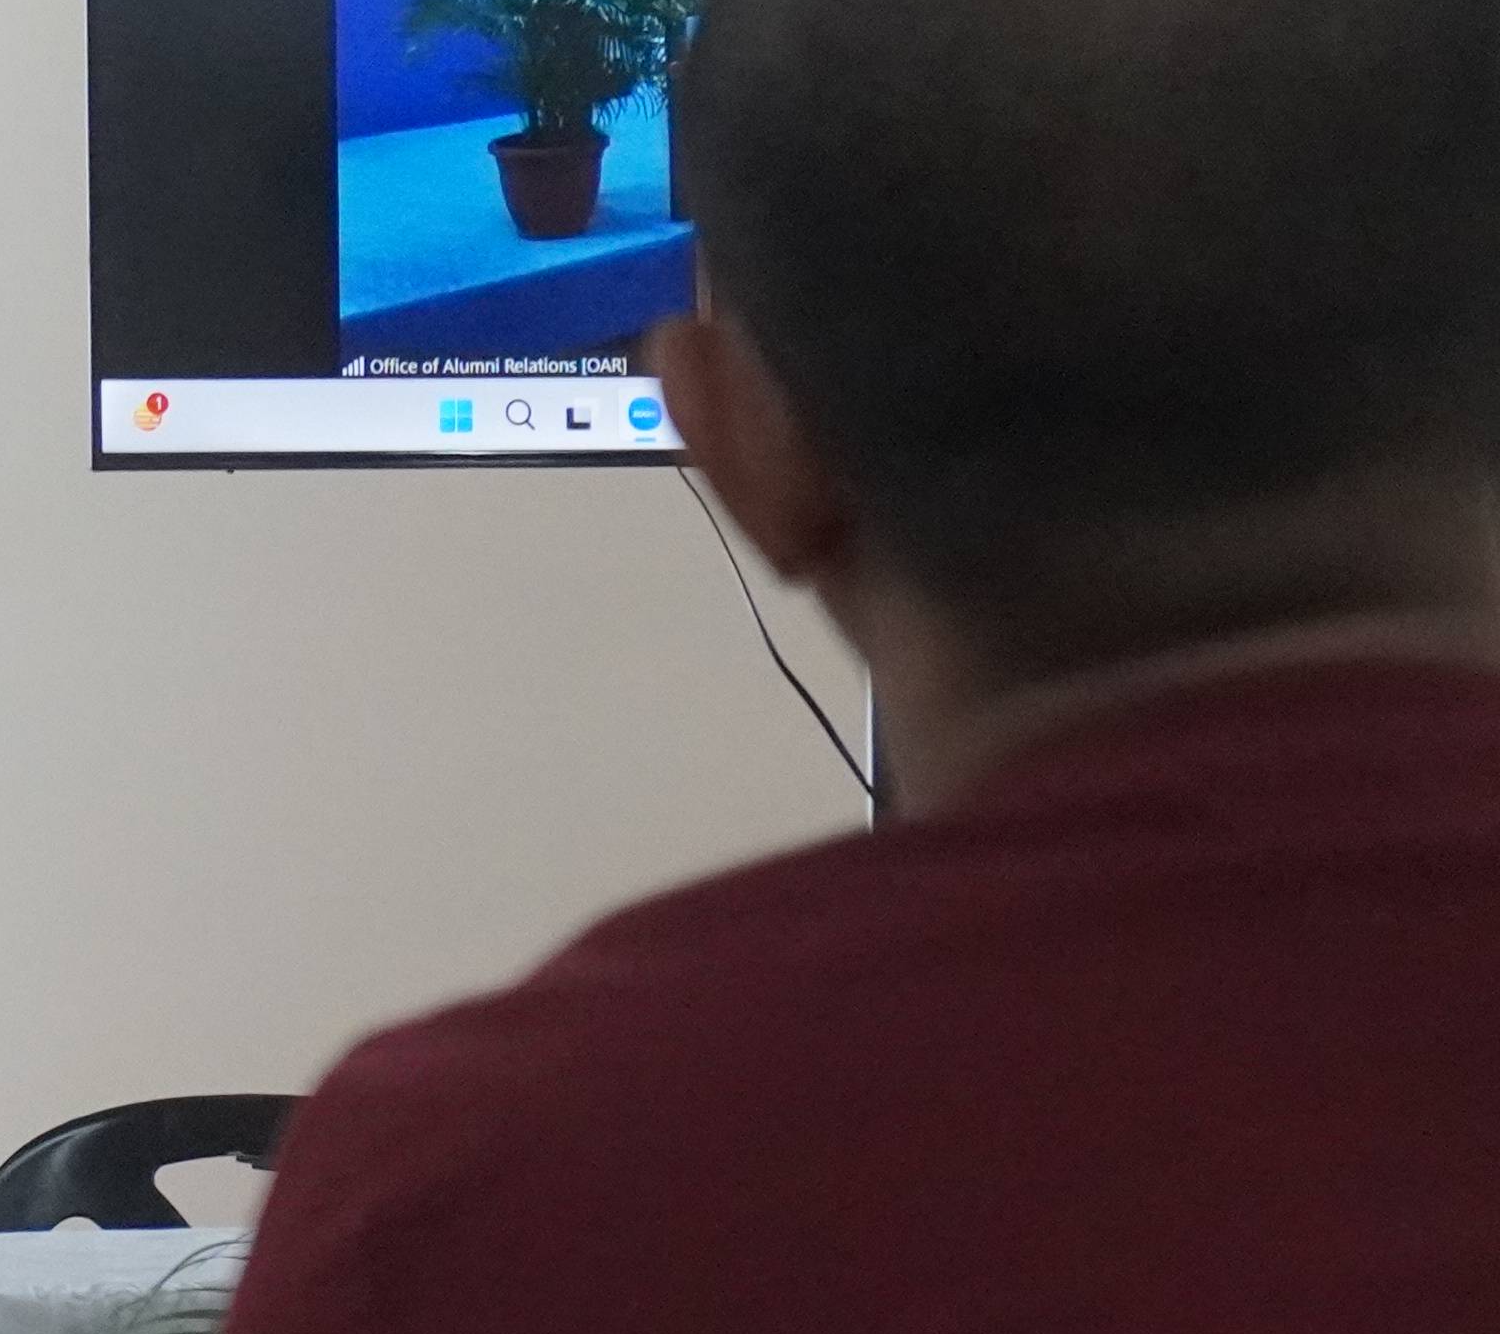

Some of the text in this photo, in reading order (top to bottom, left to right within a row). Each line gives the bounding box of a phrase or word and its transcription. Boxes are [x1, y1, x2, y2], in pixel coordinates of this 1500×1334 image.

[369, 355, 628, 376] Office of Alumni Relations [OAR]
